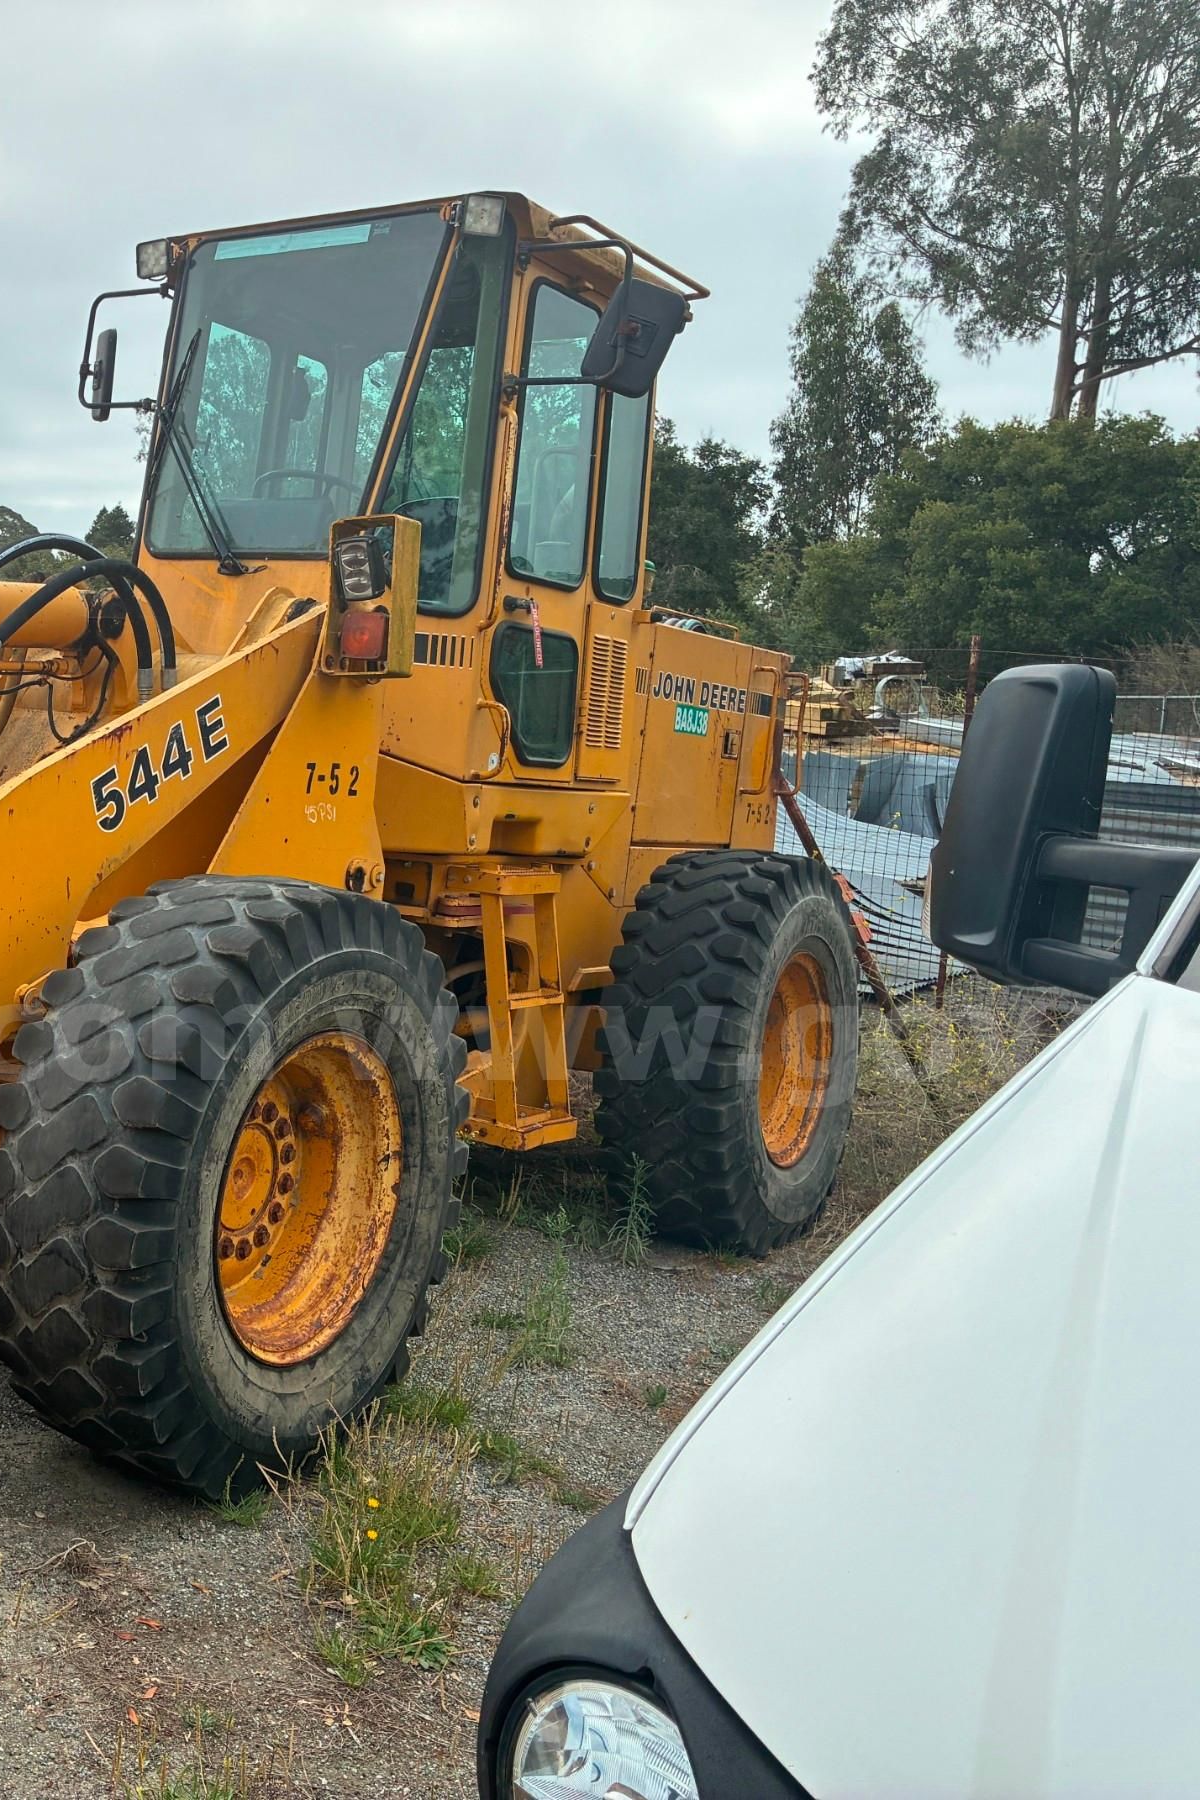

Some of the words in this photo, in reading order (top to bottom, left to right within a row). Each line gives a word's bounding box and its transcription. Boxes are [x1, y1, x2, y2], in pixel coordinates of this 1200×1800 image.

[653, 671, 696, 705] JOHN
[699, 680, 747, 715] DEERE
[675, 707, 709, 735] BA8J38
[90, 720, 195, 832] 544
[195, 694, 230, 763] E
